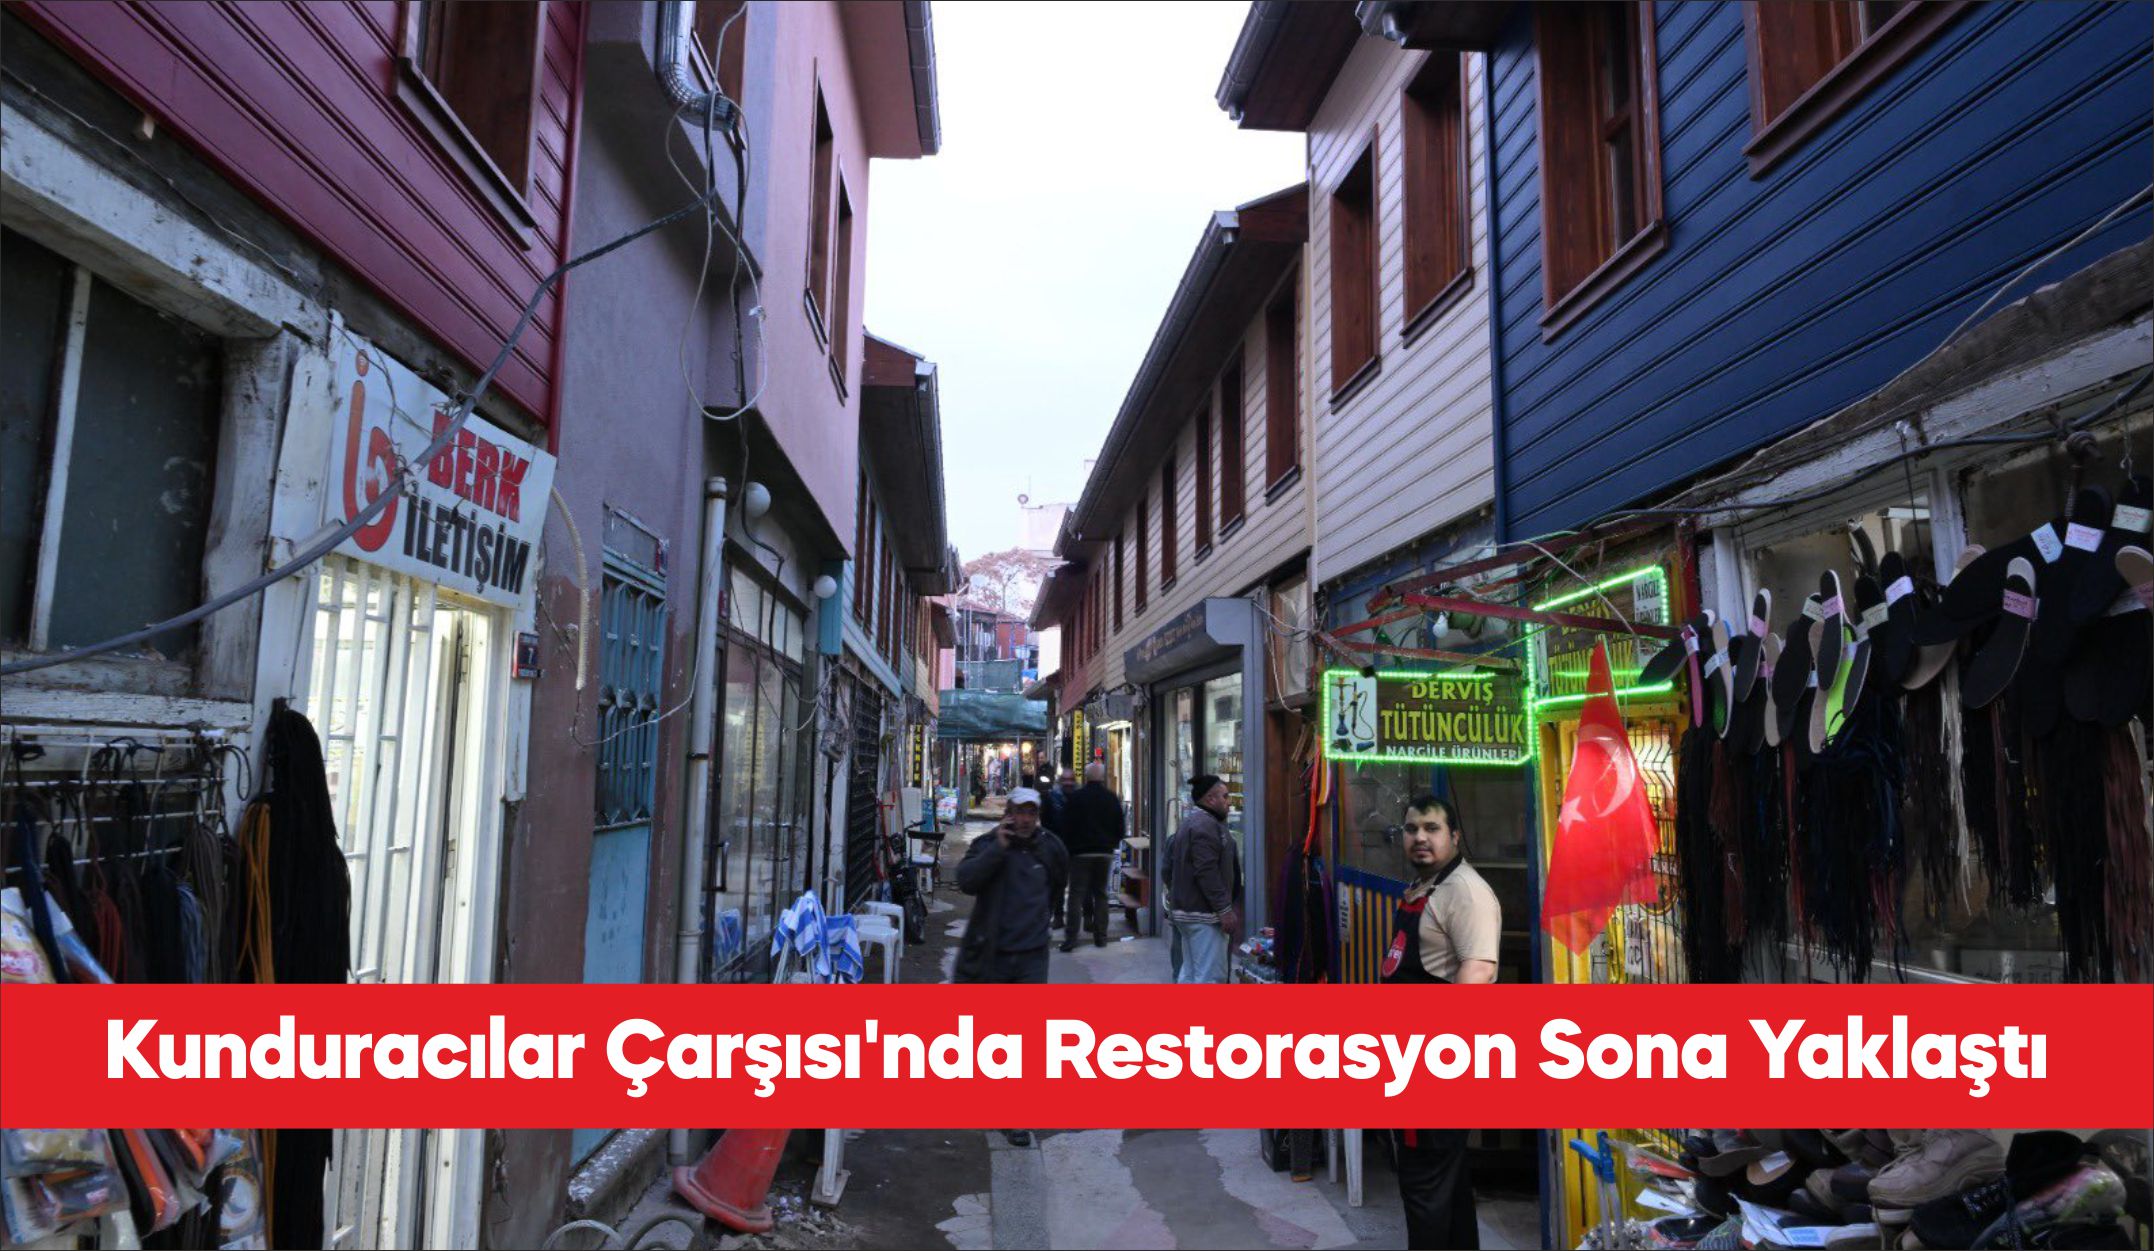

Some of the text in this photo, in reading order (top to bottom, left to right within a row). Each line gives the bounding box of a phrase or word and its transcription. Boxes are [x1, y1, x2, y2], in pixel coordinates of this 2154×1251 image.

[428, 411, 529, 523] BERK
[1380, 703, 1526, 744] TÜTÜNCÜLÜK
[1386, 744, 1446, 760] NARGİLE
[1451, 745, 1523, 761] ÜRÜNLERİ
